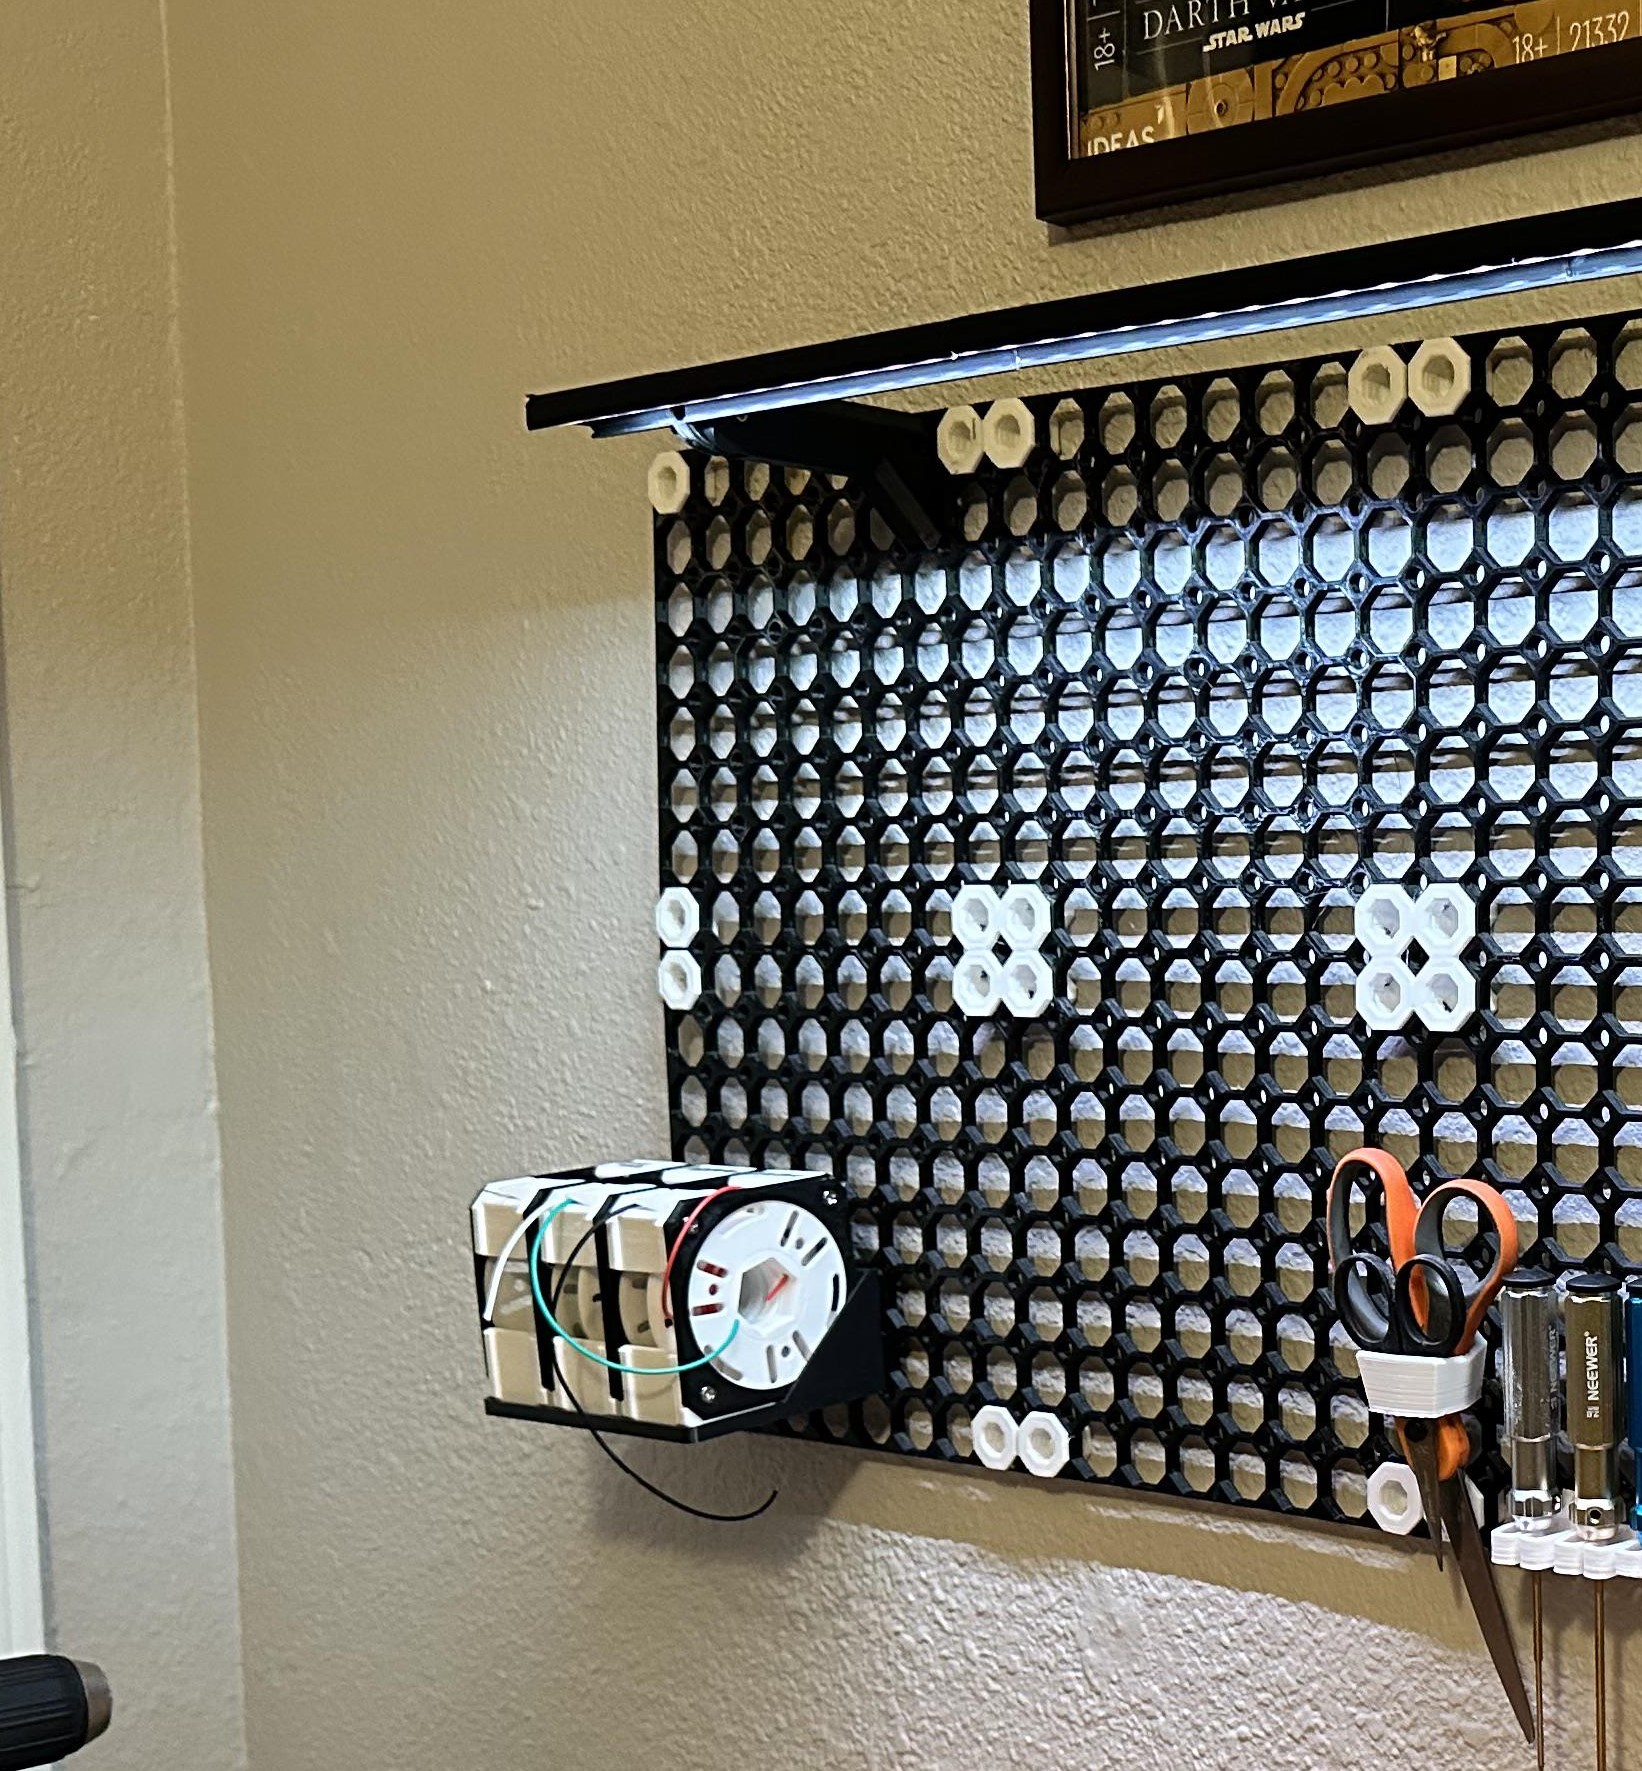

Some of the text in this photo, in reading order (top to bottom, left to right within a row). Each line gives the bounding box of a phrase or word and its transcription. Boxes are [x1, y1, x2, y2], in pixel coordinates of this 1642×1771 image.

[1143, 0, 1250, 40] DARTH
[1203, 11, 1306, 52] STAR WARS
[1569, 11, 1629, 51] 21332
[1094, 27, 1116, 71] 18+
[1512, 33, 1548, 64] 18+
[1087, 125, 1155, 156] IDEAS
[1586, 1335, 1600, 1401] NEEWER
